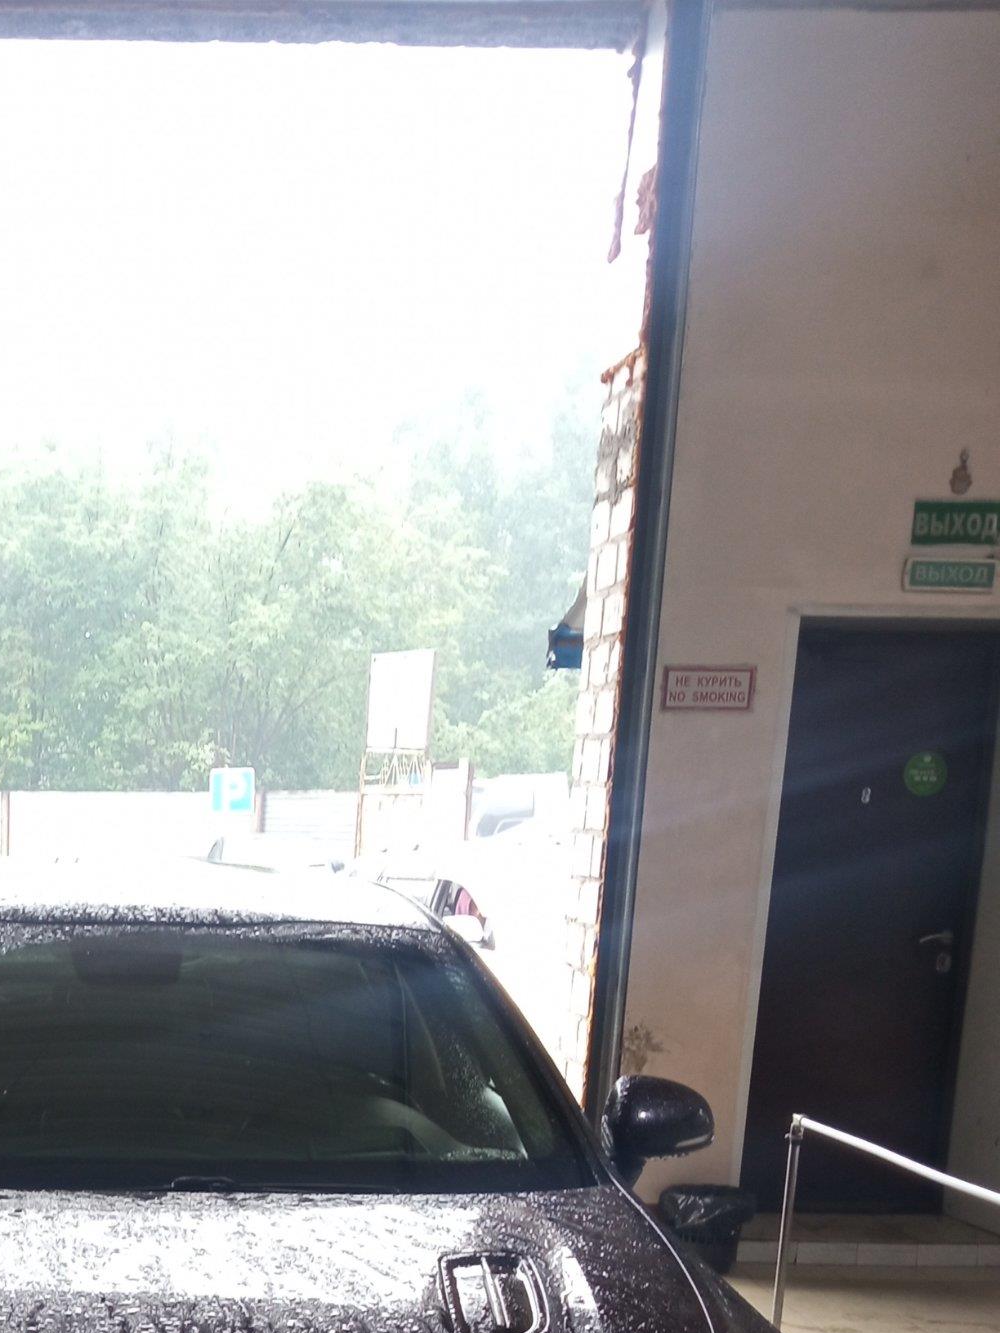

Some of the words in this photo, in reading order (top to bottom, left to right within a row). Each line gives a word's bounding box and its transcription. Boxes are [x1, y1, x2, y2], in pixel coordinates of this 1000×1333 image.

[914, 511, 1000, 542] ВЫХОД
[916, 564, 989, 583] ВЫХОД
[676, 675, 690, 688] НЕ
[697, 675, 741, 688] КУРИТЬ
[669, 691, 686, 702] NO
[693, 691, 746, 703] SMOKING
